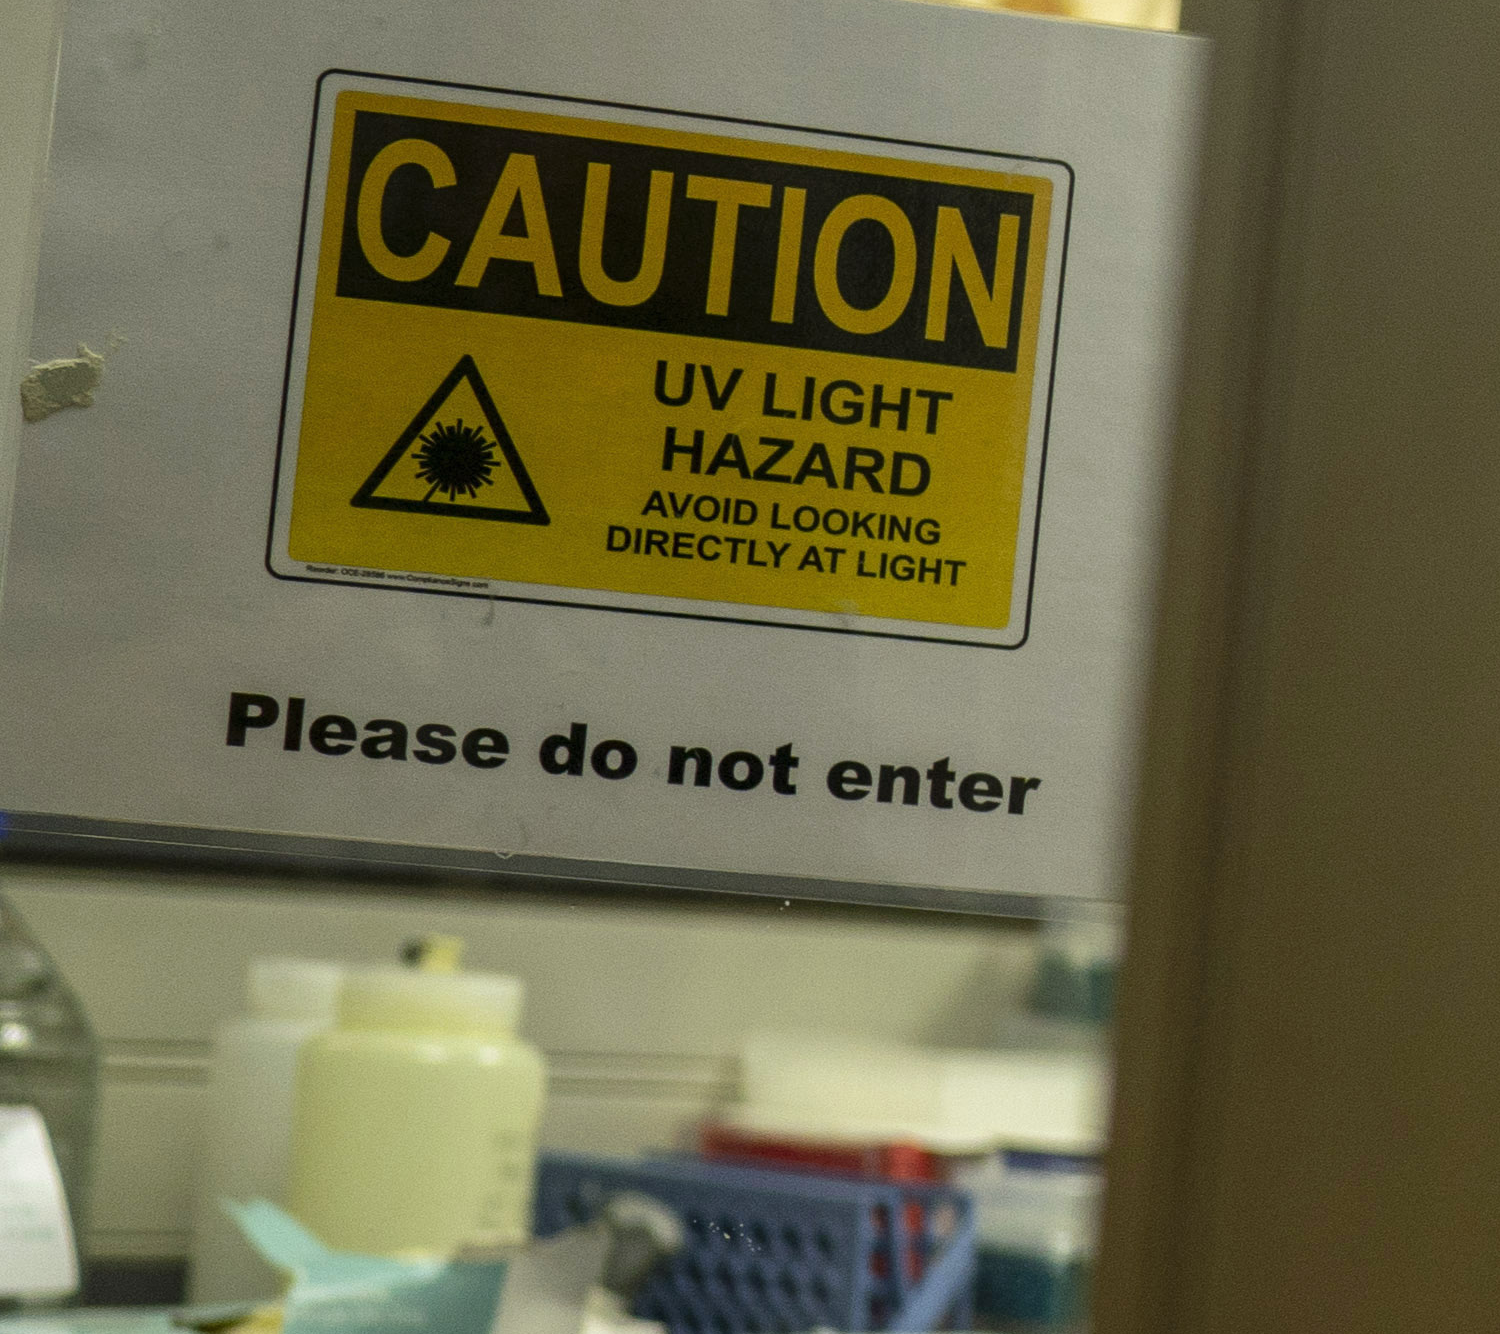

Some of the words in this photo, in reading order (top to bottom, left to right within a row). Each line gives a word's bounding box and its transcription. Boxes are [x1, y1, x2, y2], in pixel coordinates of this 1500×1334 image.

[355, 138, 1021, 350] CAUTION
[654, 360, 743, 410] UV
[762, 372, 953, 434] LIGHT
[662, 427, 930, 496] HAZARD
[642, 490, 758, 525] AVOID
[770, 502, 940, 545] LOOKING
[606, 525, 790, 568] DIRECTLY
[798, 545, 845, 573] AT
[857, 551, 966, 586] LIGHT
[227, 693, 509, 768] Please
[539, 723, 637, 779] do
[668, 744, 798, 795] not
[827, 758, 1040, 814] enter
